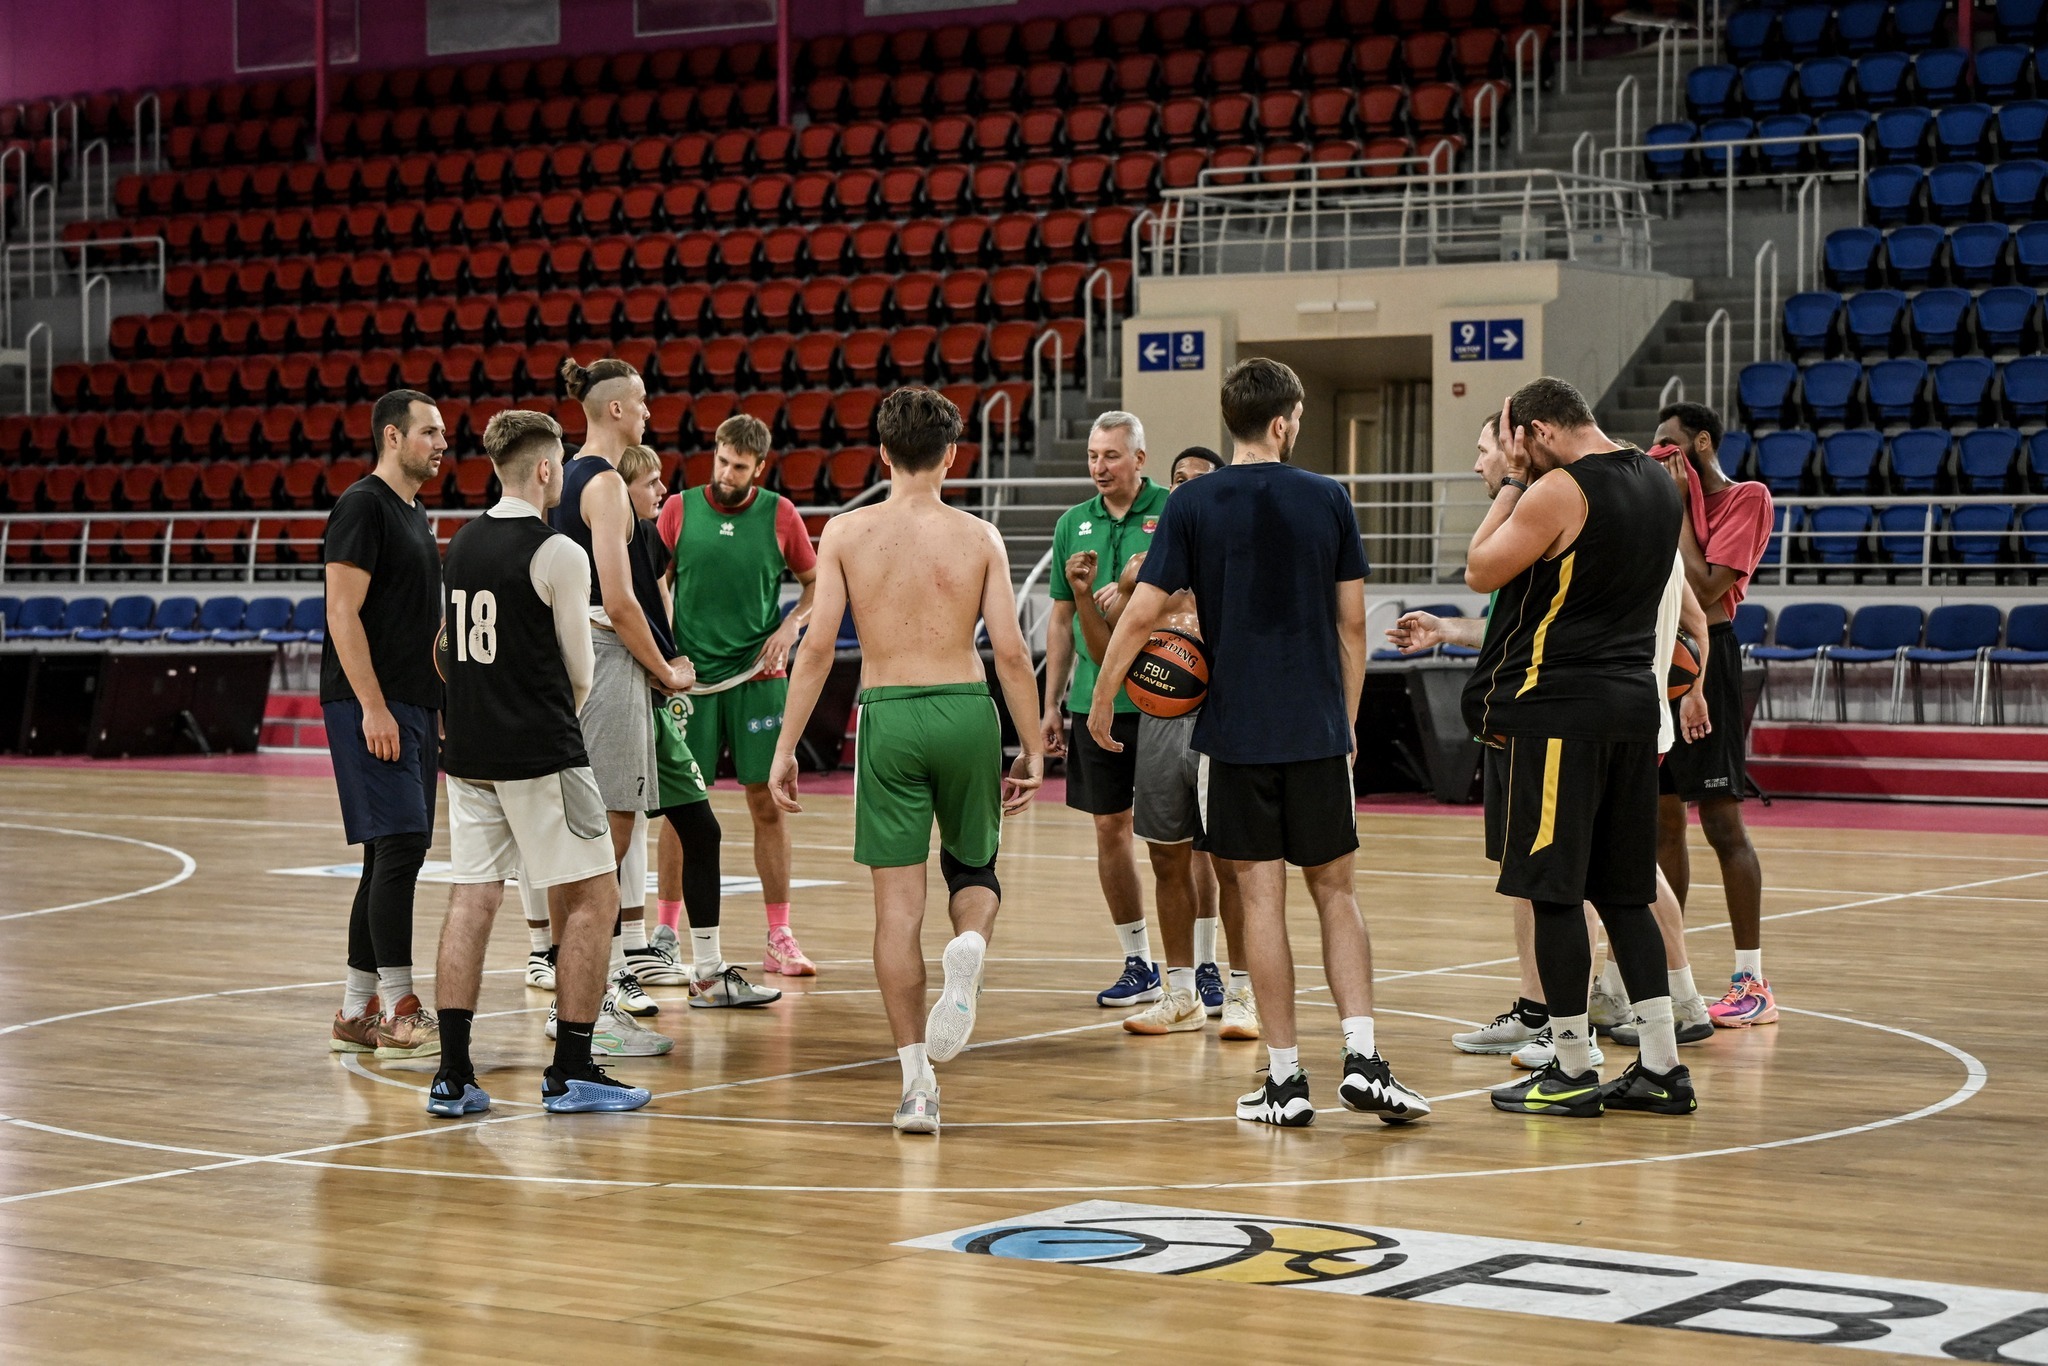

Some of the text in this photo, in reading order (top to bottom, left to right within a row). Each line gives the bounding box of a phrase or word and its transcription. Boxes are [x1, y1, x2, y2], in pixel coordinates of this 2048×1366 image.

[1180, 333, 1195, 354] 8
[1460, 323, 1475, 345] 9
[451, 589, 498, 665] 18
[1145, 637, 1199, 669] PALDING
[1143, 661, 1171, 681] FBU
[1139, 673, 1176, 692] FAVBET
[636, 776, 646, 797] 7
